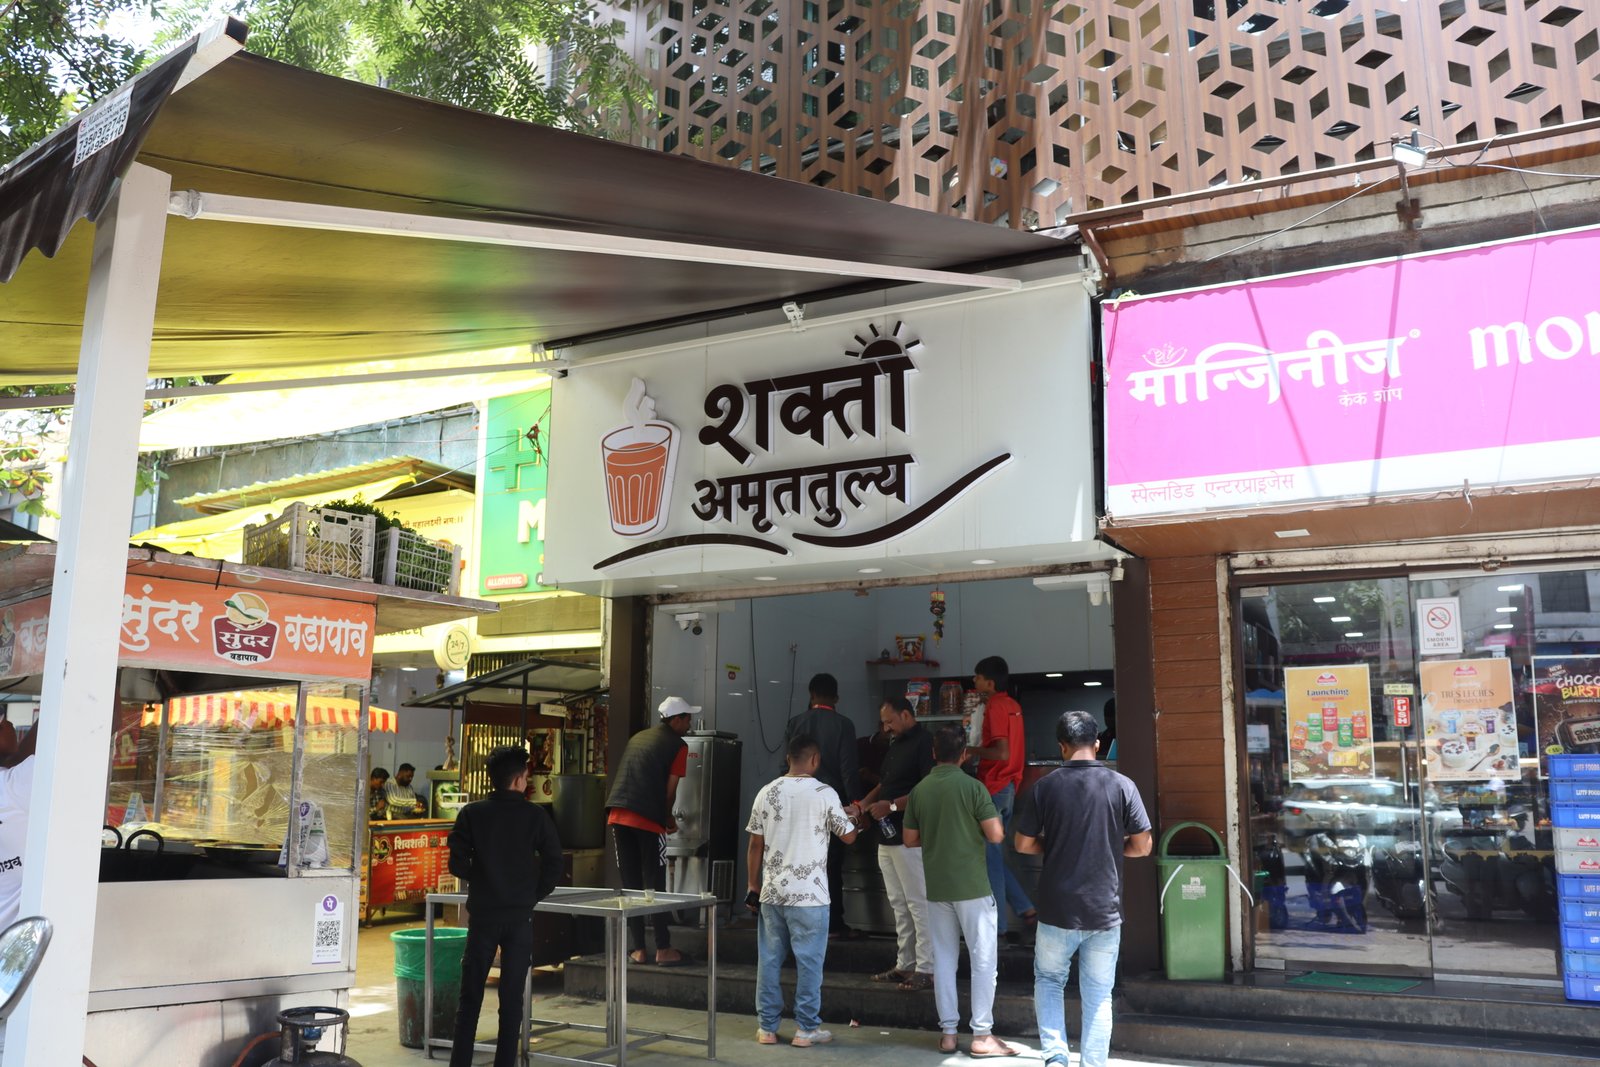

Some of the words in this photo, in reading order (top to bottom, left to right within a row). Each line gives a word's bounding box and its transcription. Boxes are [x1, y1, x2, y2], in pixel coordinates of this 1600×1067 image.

[691, 454, 916, 533] अमृततुल्य
[487, 576, 523, 587] ALLOPATHIC
[119, 584, 203, 652] सुंदर
[219, 628, 271, 649] सुंदर
[284, 613, 369, 658] वडापाव
[230, 652, 259, 662] वडापाव
[1549, 664, 1562, 672] NEW
[1307, 688, 1349, 697] Launching
[1441, 690, 1461, 698] TRES
[1463, 688, 1495, 698] LECHES
[1561, 685, 1600, 699] BURST
[1396, 699, 1408, 724] PUSH
